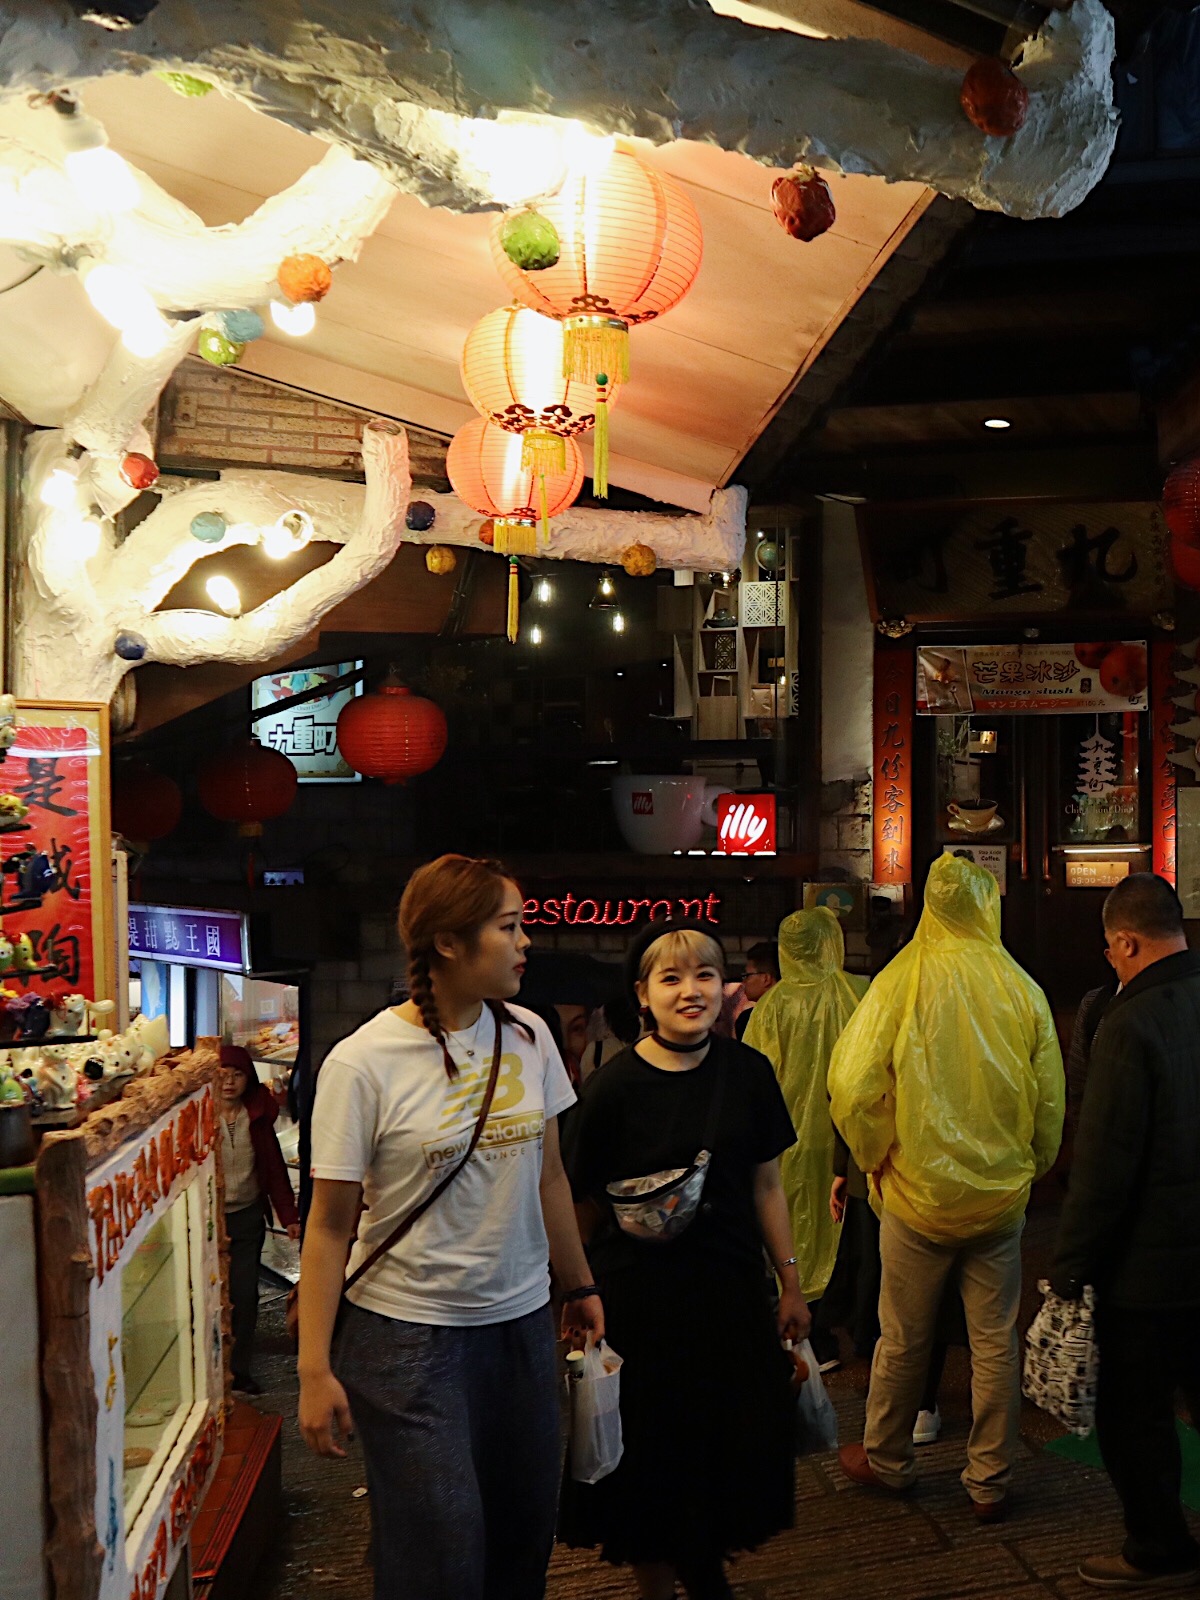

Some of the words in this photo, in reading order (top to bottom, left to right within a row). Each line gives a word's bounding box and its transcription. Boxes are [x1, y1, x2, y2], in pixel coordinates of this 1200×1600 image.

[972, 660, 1081, 684] 芒果冰沙
[982, 688, 1032, 697] Mango
[1035, 687, 1075, 695] slush
[269, 714, 338, 757] 九重町
[633, 794, 653, 812] illy
[720, 803, 767, 847] illy
[1070, 867, 1097, 875] OPEN
[523, 889, 722, 925] estaurant
[430, 1140, 469, 1164] new
[477, 1119, 544, 1143] alance
[486, 1147, 526, 1161] SINCE
